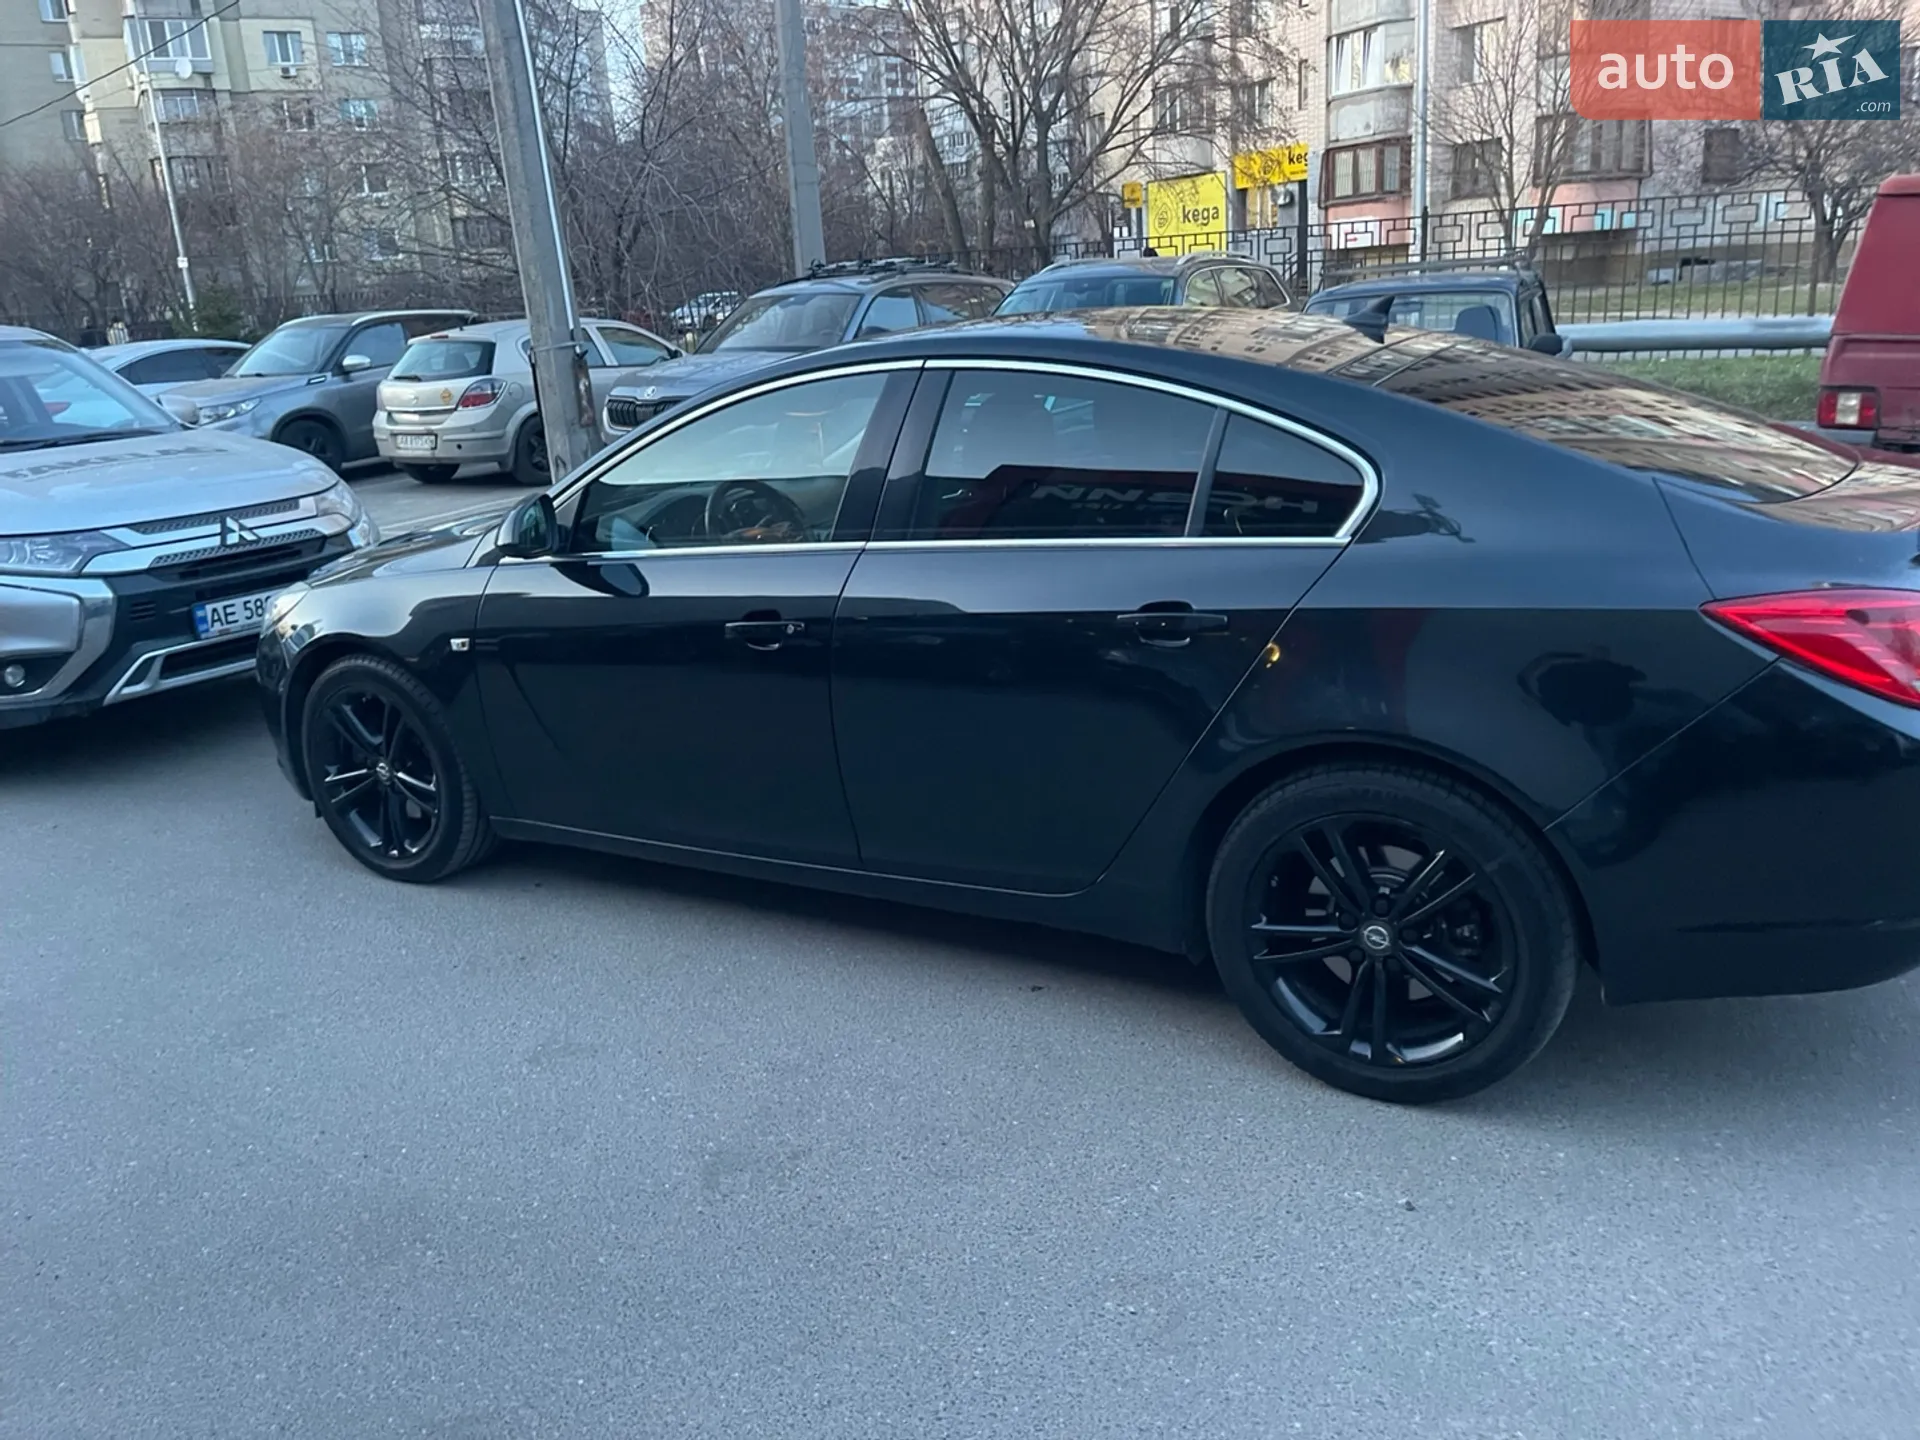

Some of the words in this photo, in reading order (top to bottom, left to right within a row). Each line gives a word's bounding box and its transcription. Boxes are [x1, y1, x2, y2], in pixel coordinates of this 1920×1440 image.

[1182, 205, 1219, 227] kega
[210, 603, 239, 628] AE
[243, 596, 271, 620] 58
